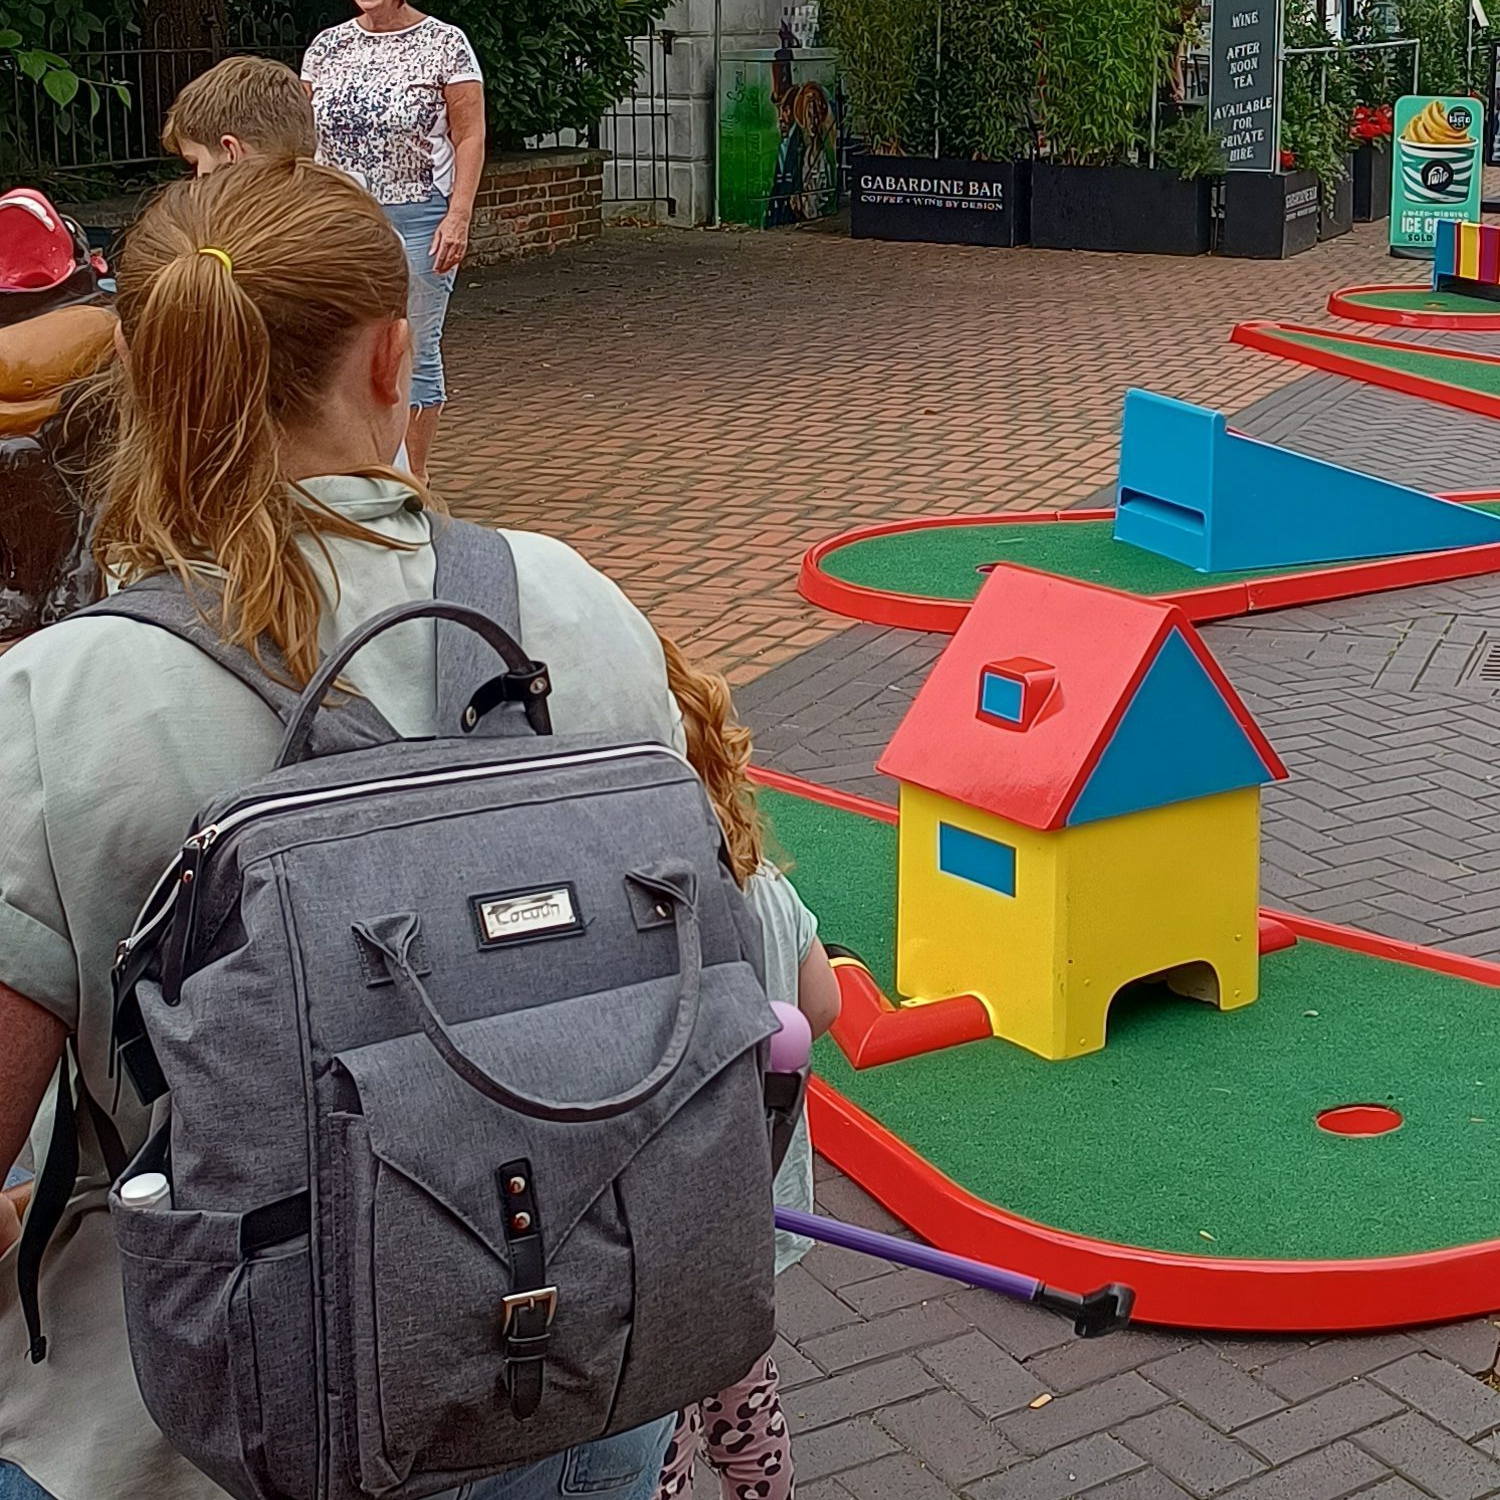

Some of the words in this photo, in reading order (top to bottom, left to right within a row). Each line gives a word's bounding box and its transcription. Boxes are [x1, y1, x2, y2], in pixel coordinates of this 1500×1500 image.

[1231, 11, 1260, 28] WINE
[1226, 42, 1261, 60] AFTER
[1229, 56, 1259, 75] NOON
[1233, 73, 1254, 90] TEA
[1213, 97, 1273, 121] AVAILABLE
[1233, 116, 1253, 131] FOR
[1221, 129, 1265, 150] PRIVATE
[1230, 146, 1255, 163] HIRE
[860, 175, 964, 195] GABARDINE
[968, 181, 1003, 197] BAR
[860, 194, 904, 204] COFFEE
[912, 197, 943, 207] WINE
[945, 200, 959, 208] BY
[1401, 217, 1422, 234] ICE
[1407, 234, 1434, 242] SOLD
